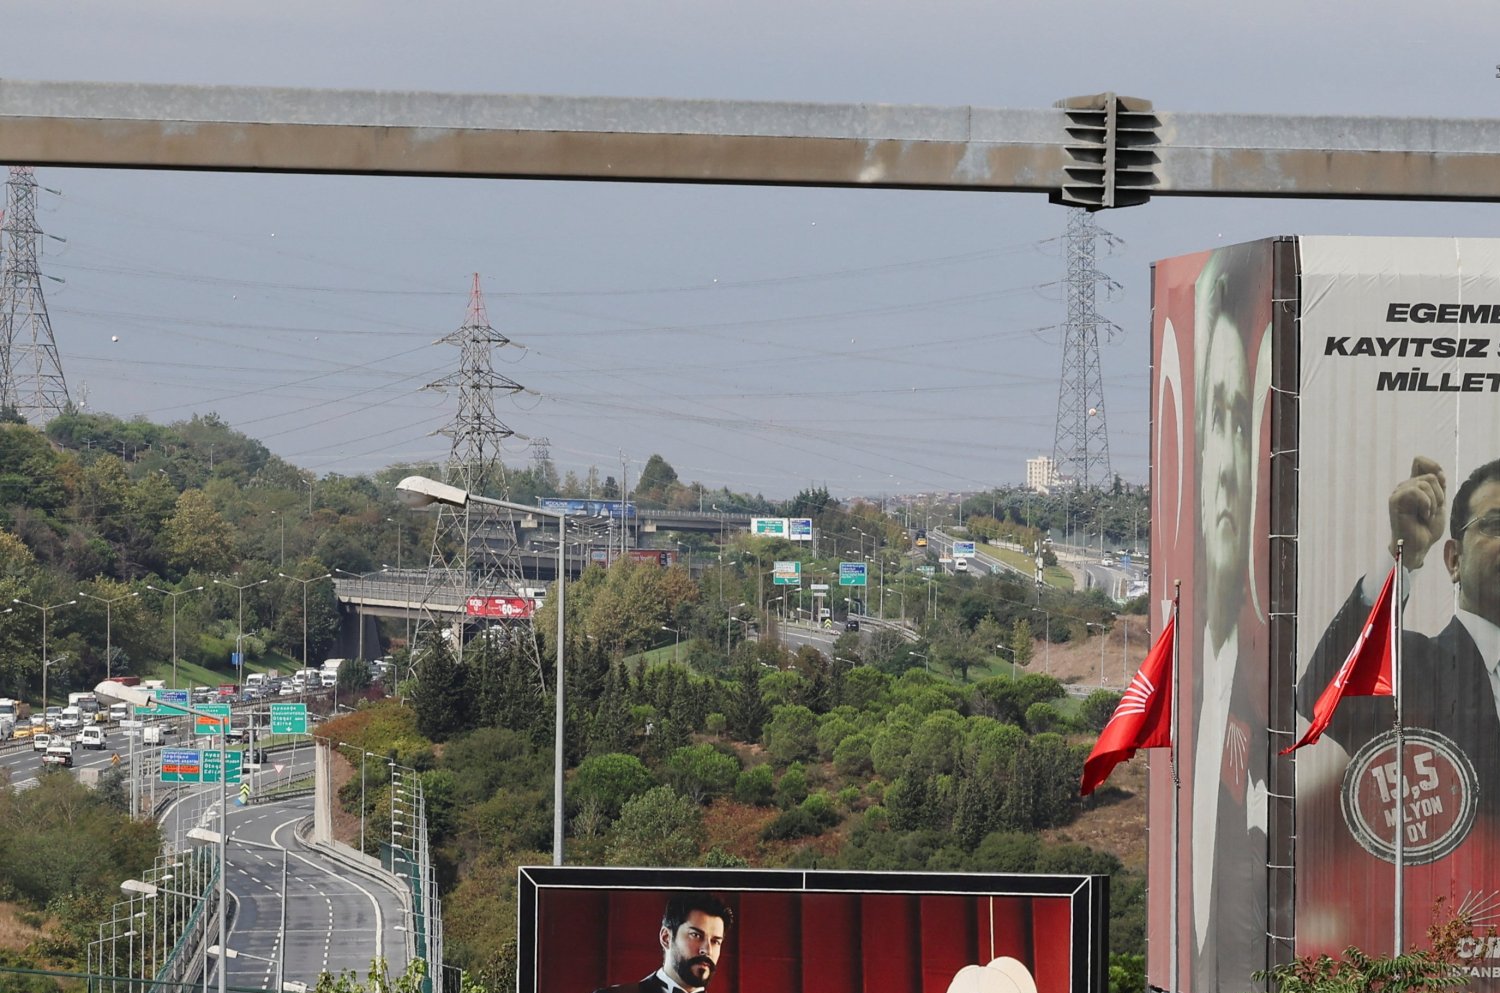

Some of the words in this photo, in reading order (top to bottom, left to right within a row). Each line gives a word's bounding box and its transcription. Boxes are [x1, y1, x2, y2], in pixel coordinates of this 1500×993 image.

[1324, 336, 1490, 358] KAYITSIZ
[1384, 796, 1443, 827] MLYON
[1406, 821, 1428, 842] OY
